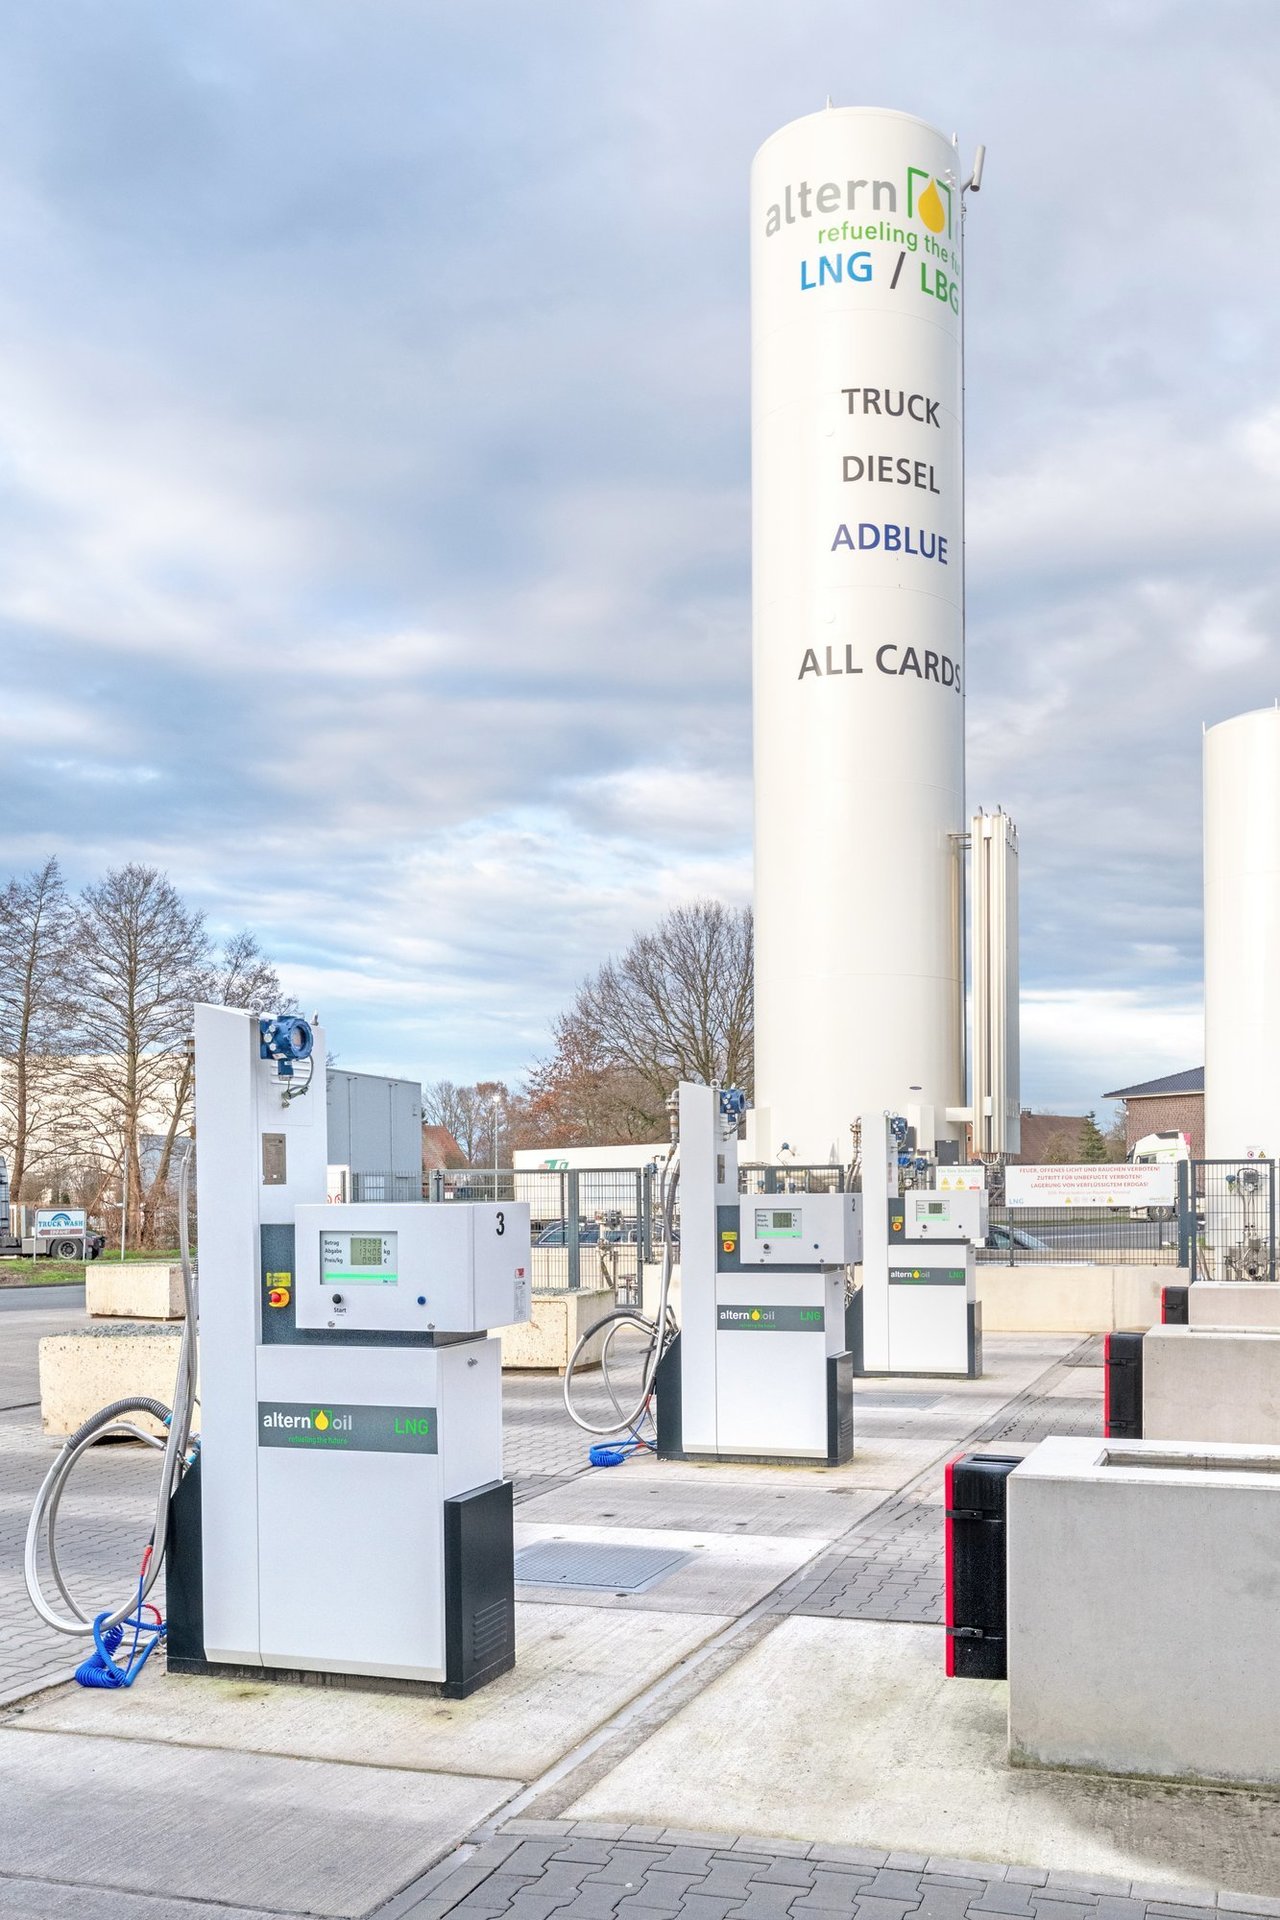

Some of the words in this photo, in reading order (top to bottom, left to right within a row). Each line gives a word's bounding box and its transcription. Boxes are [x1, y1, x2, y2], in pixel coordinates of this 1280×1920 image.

[818, 221, 918, 251] refueling
[924, 234, 948, 263] the
[801, 251, 873, 291] LNG
[889, 251, 906, 290] /
[921, 262, 959, 316] LBG
[841, 388, 940, 428] TRUCK
[842, 455, 940, 494] DIESEL
[831, 523, 948, 565] ADBLUE
[797, 644, 863, 680] ALL
[876, 644, 961, 694] CARDS
[496, 1212, 505, 1236] 3
[762, 1311, 775, 1320] oil
[800, 1312, 822, 1320] LNG
[332, 1415, 352, 1430] oil
[394, 1418, 430, 1436] LNG
